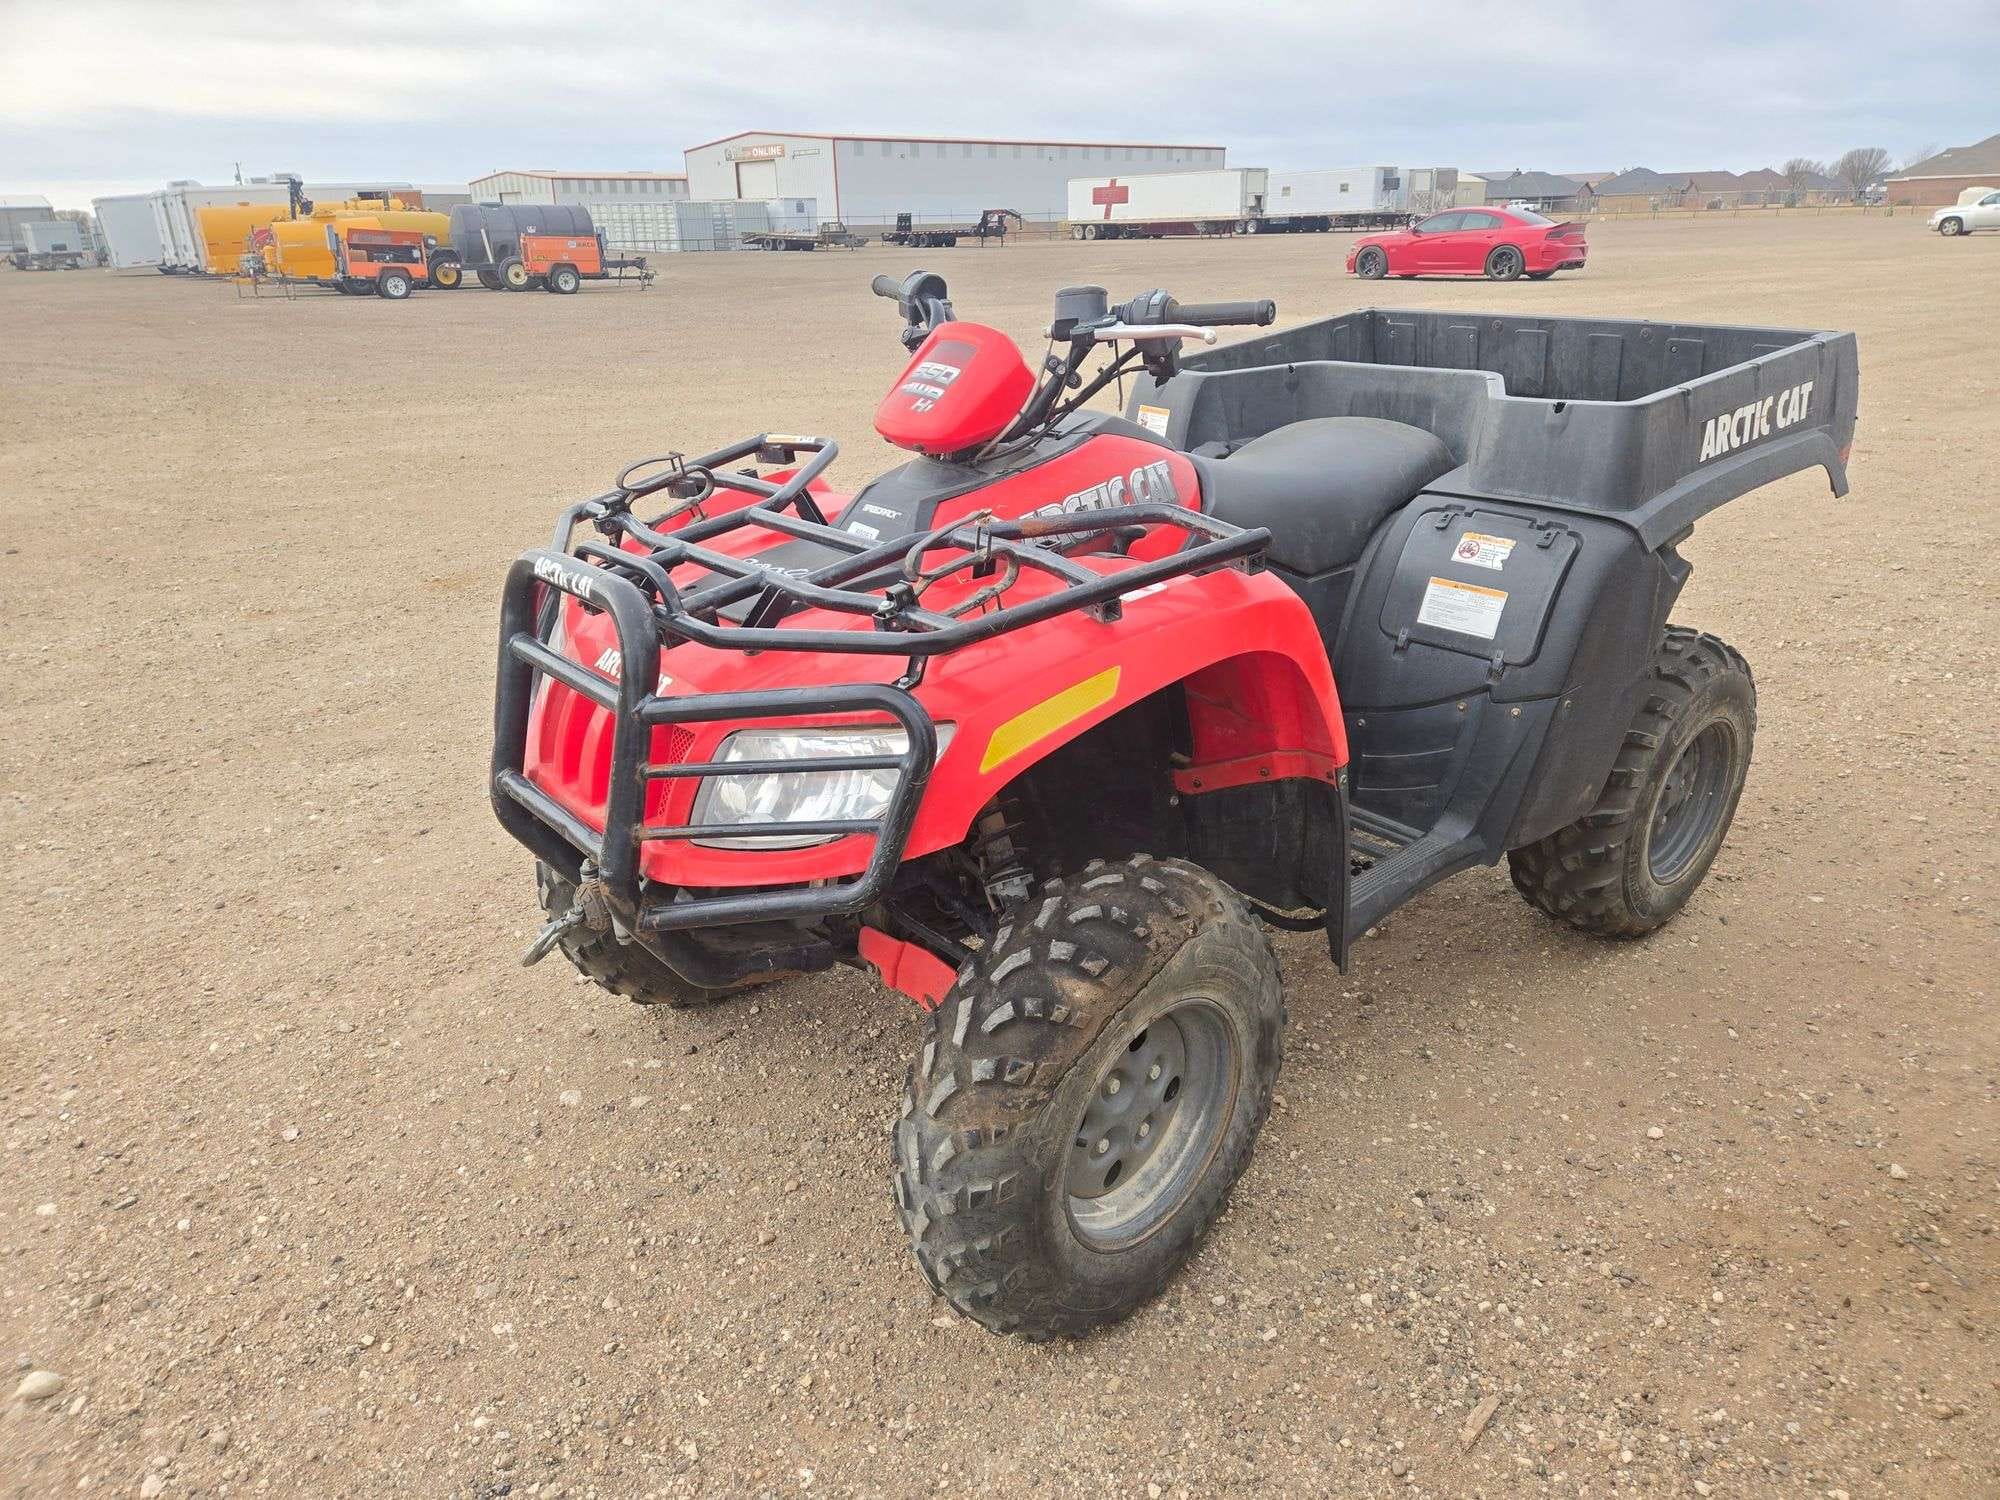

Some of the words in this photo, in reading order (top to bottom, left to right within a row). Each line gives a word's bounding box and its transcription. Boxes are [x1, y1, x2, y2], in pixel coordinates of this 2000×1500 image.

[752, 145, 783, 157] ONLINE
[1699, 396, 1774, 463] ARCTIC
[1776, 381, 1814, 429] CAT
[1130, 459, 1179, 505] CAT
[593, 647, 621, 679] ARC
